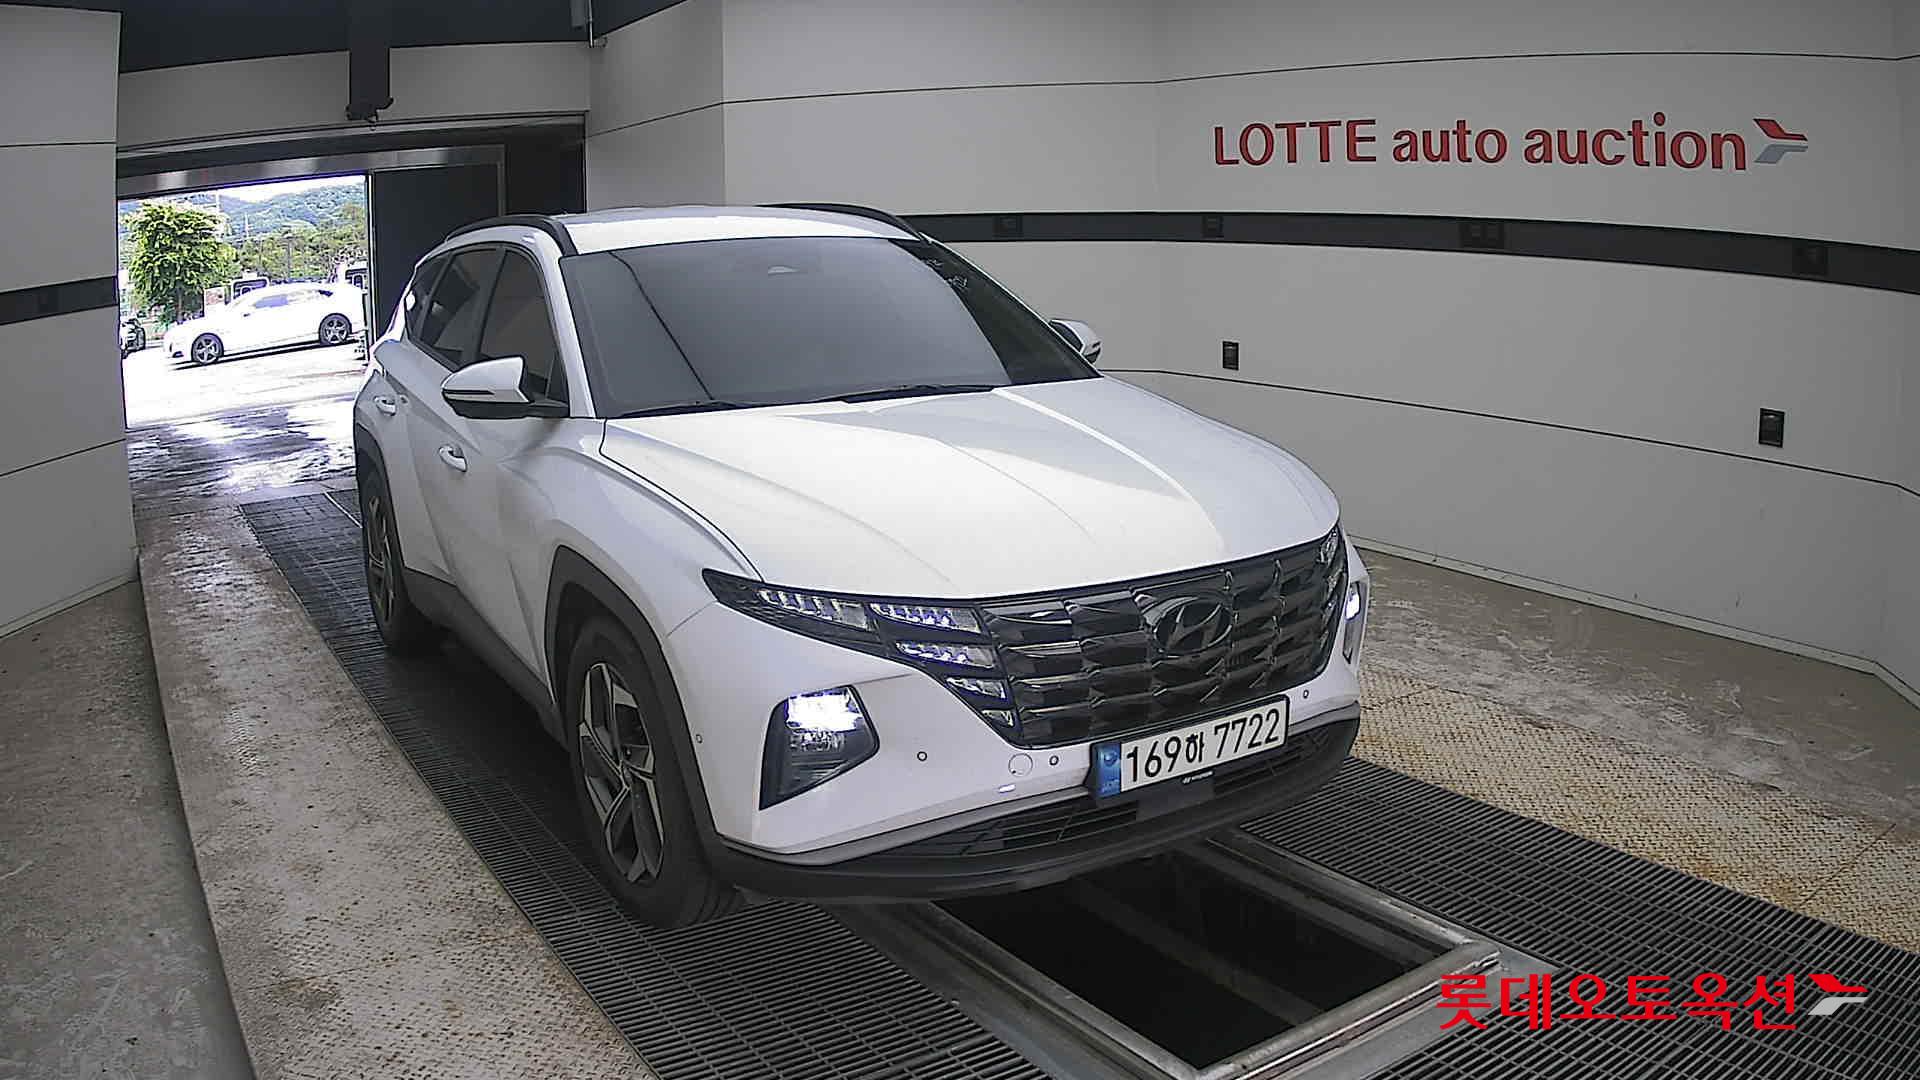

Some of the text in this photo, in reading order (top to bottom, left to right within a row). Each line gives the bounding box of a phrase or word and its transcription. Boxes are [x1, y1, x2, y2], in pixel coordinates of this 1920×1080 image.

[1214, 111, 1747, 171] LOTTE auto auction
[1126, 708, 1281, 783] 169하 7722
